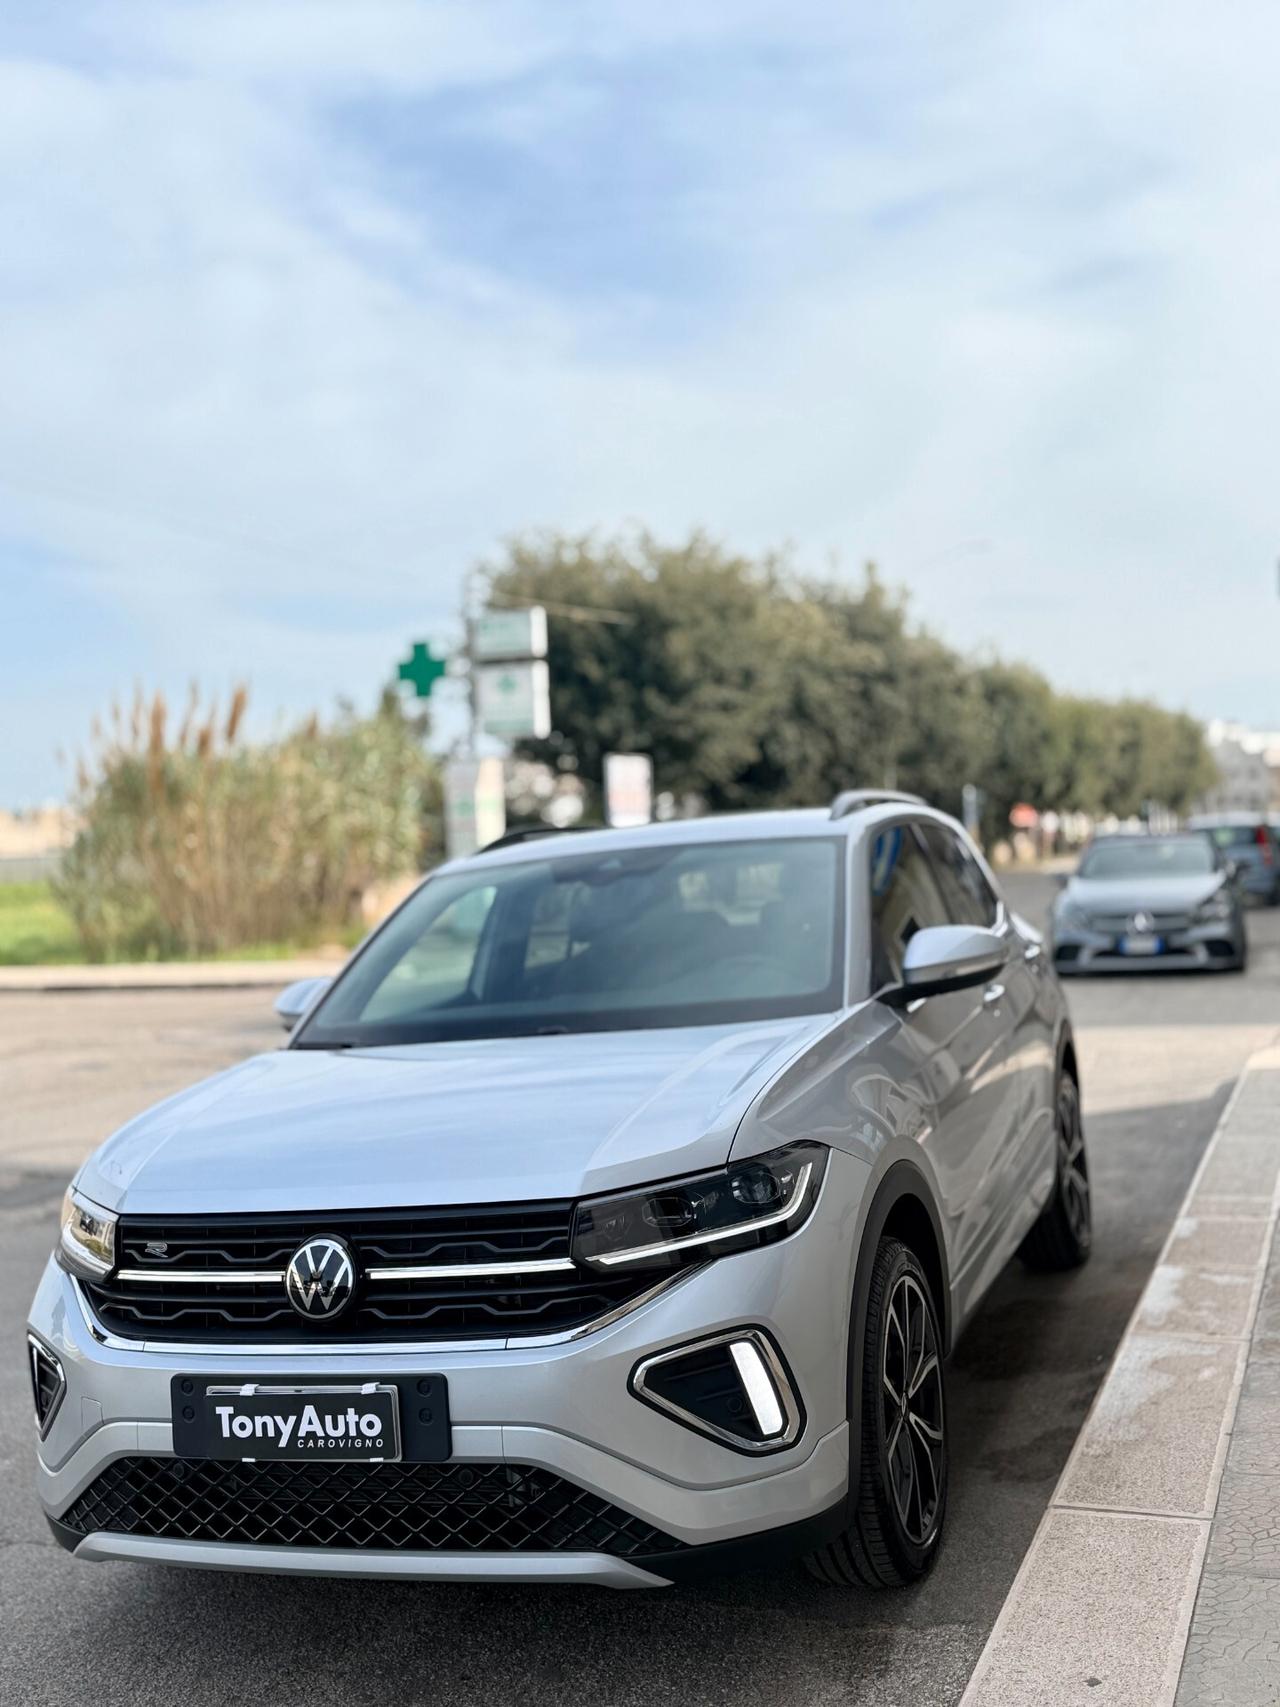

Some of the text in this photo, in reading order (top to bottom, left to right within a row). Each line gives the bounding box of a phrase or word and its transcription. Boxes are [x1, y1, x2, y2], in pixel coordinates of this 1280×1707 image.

[288, 1240, 352, 1317] VW
[215, 1405, 382, 1448] TonyAuto
[297, 1438, 384, 1448] CAROVIGNO
